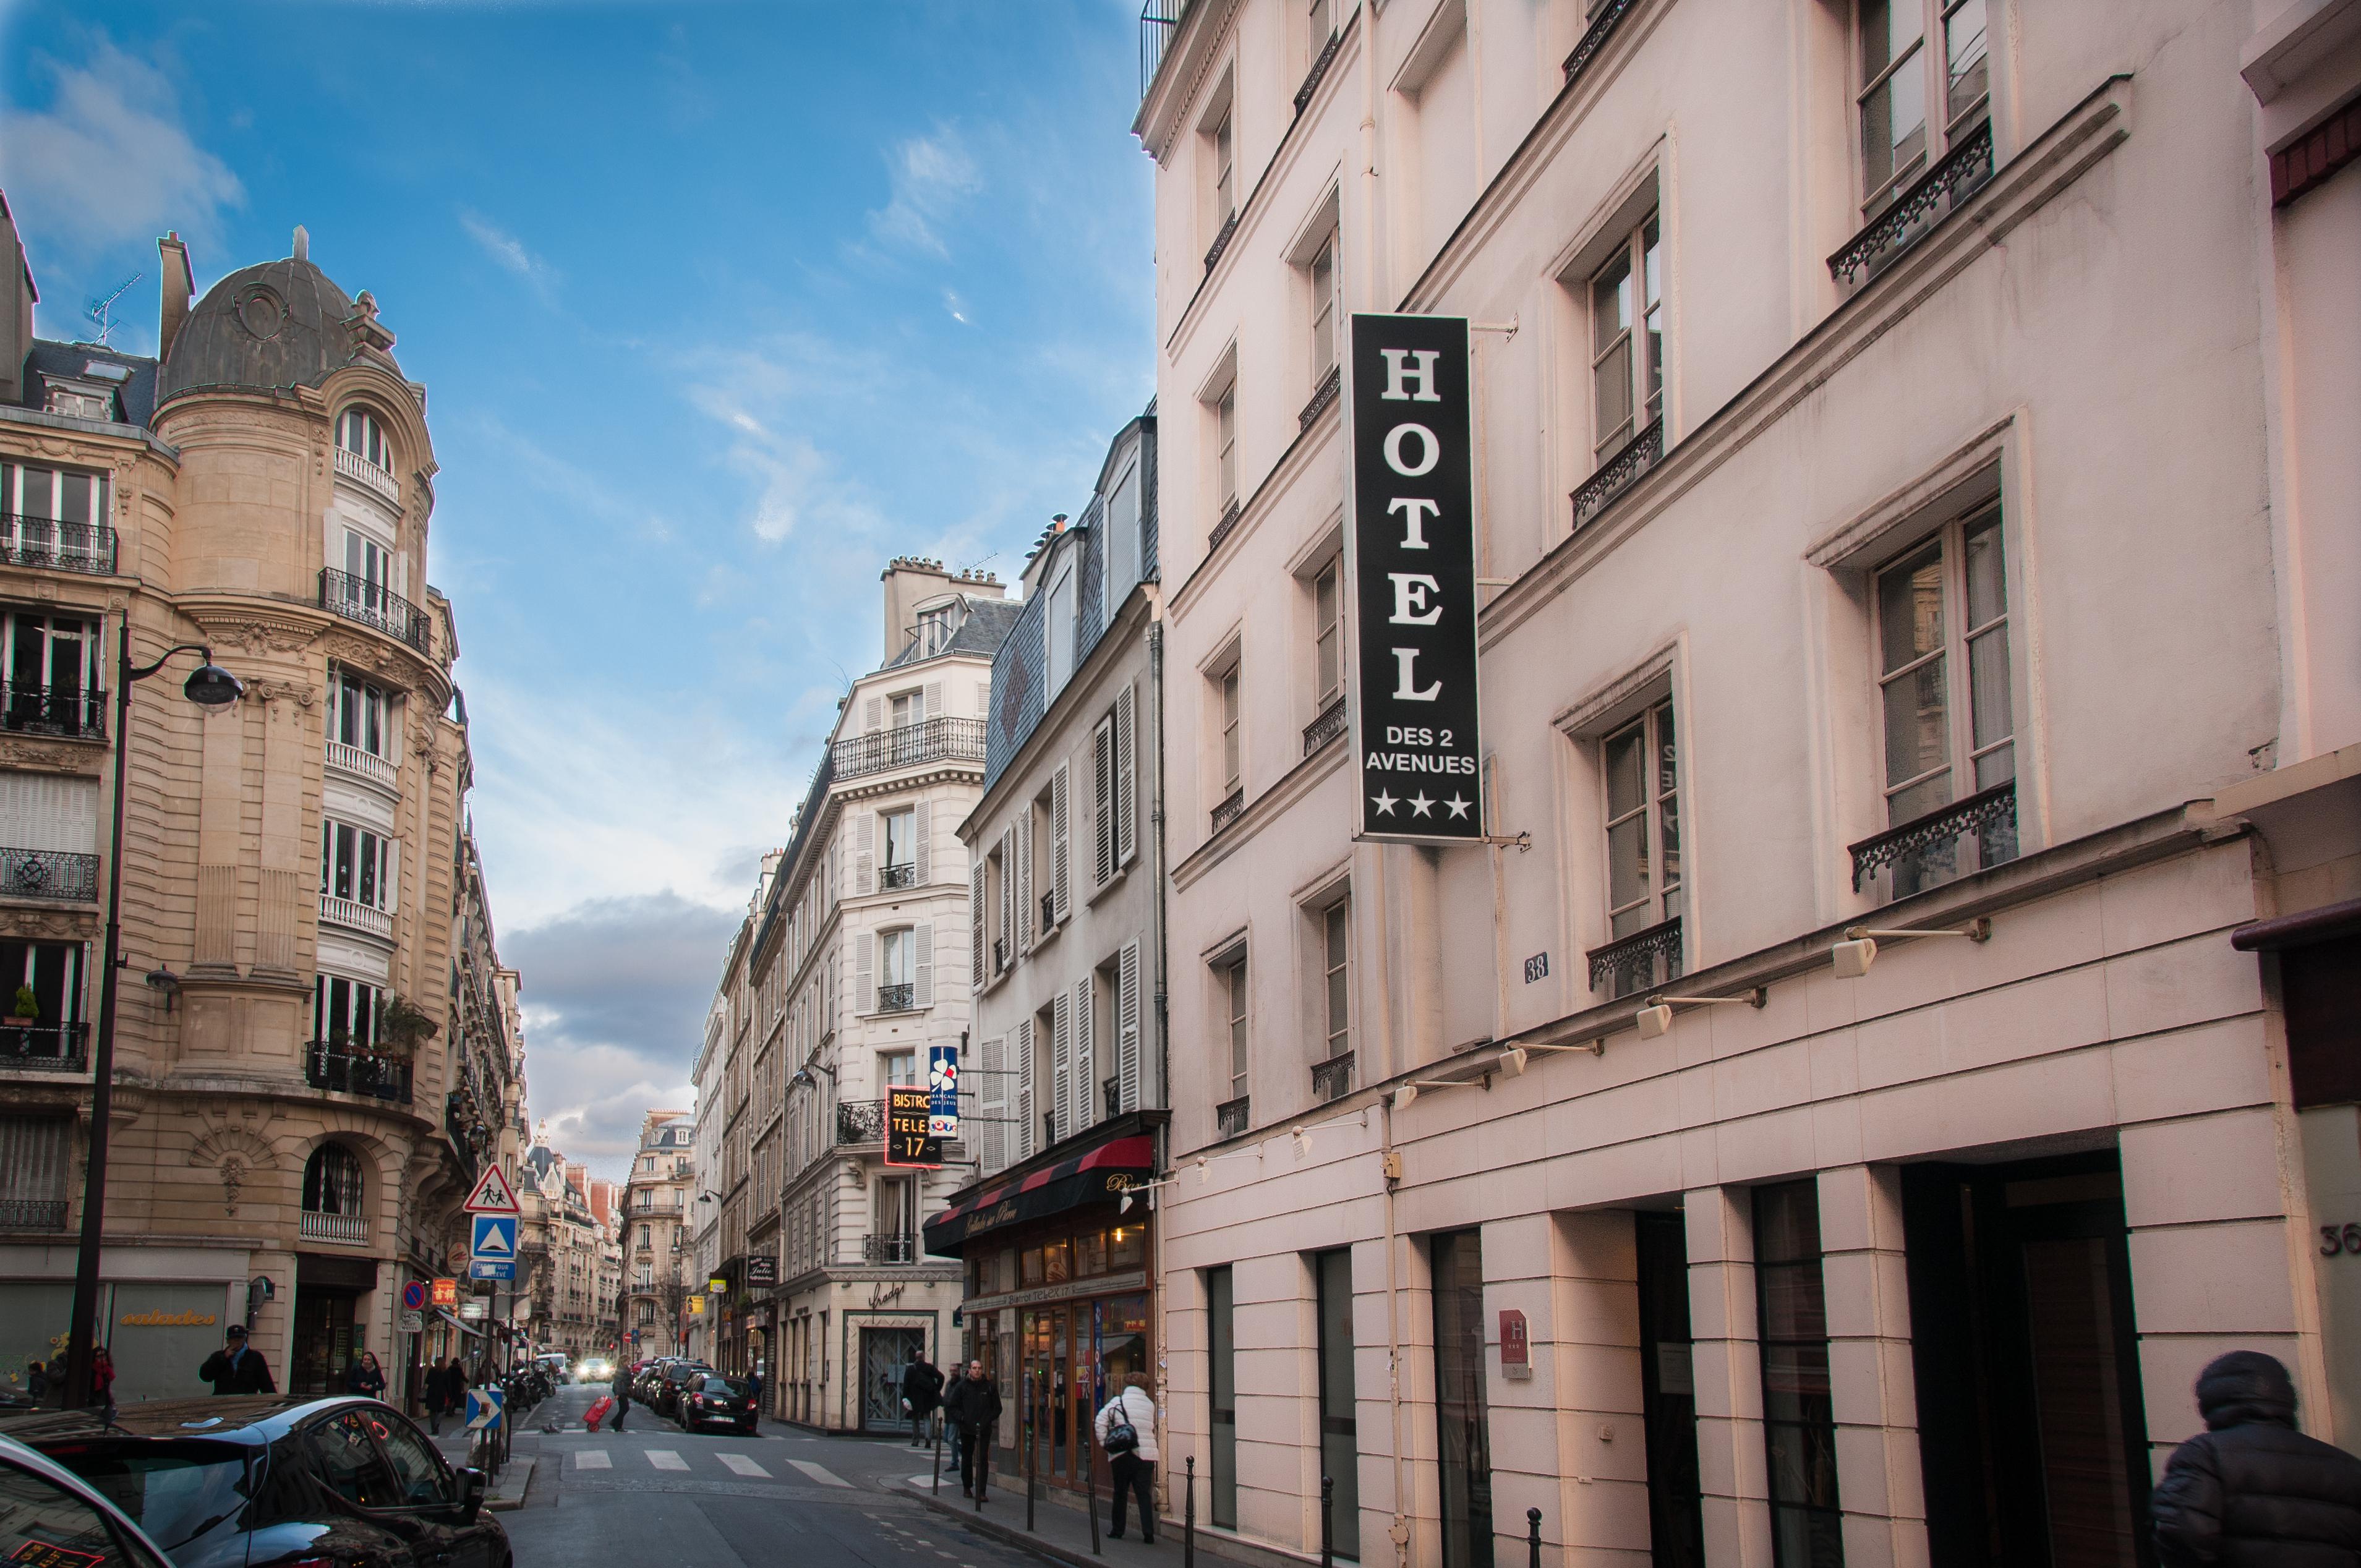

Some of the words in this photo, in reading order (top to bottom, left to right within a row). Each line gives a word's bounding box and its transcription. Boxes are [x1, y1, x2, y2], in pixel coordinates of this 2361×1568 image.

[1381, 349, 1442, 701] HOTEL
[1386, 727, 1435, 746] DES
[1440, 730, 1453, 748] 2
[1366, 753, 1476, 776] AVENUES
[1527, 955, 1545, 982] 38
[893, 1118, 930, 1133] TELE
[905, 1136, 925, 1157] 17
[1106, 1173, 1143, 1191] Bar
[2319, 1222, 2361, 1256] 36
[749, 1266, 772, 1276] Julie
[120, 1308, 216, 1326] salades
[1511, 1320, 1524, 1340] H
